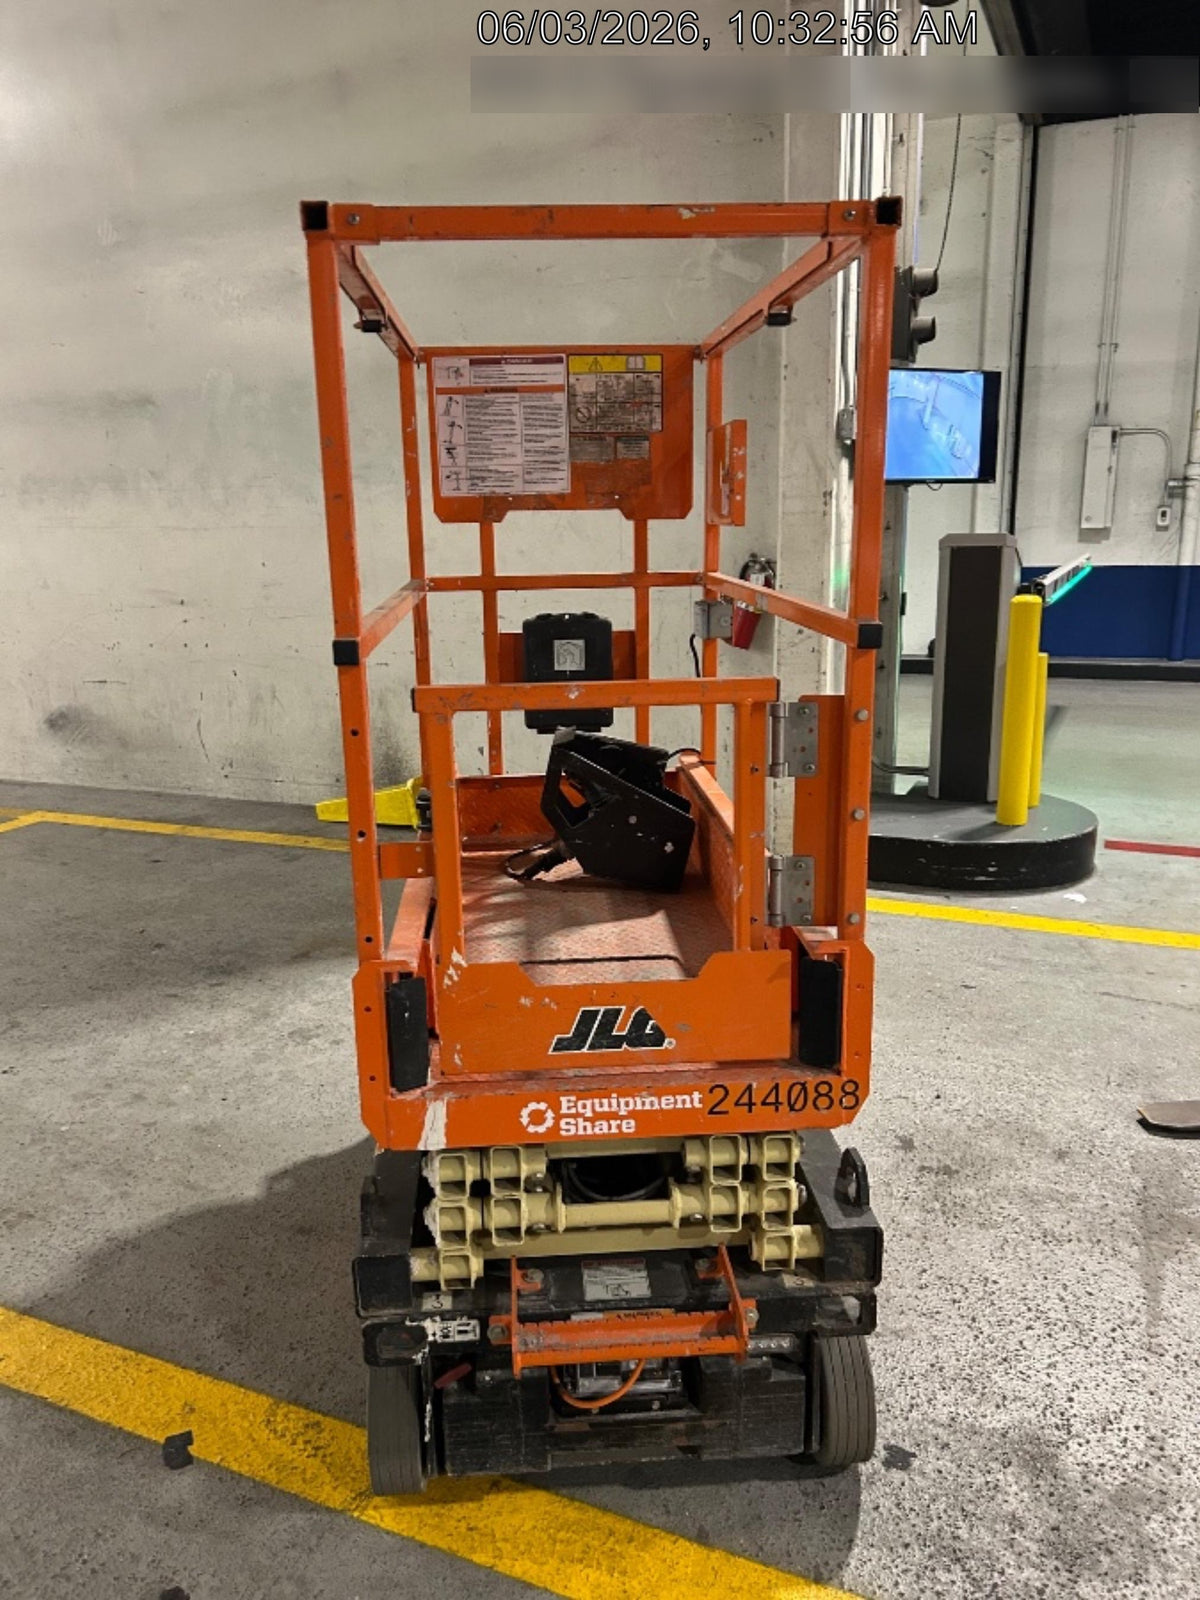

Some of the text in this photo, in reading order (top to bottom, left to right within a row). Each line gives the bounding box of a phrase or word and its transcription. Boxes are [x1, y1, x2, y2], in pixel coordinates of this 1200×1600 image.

[549, 1006, 666, 1054] JLG
[560, 1080, 860, 1116] Equipment 244088
[559, 1118, 635, 1135] Share
